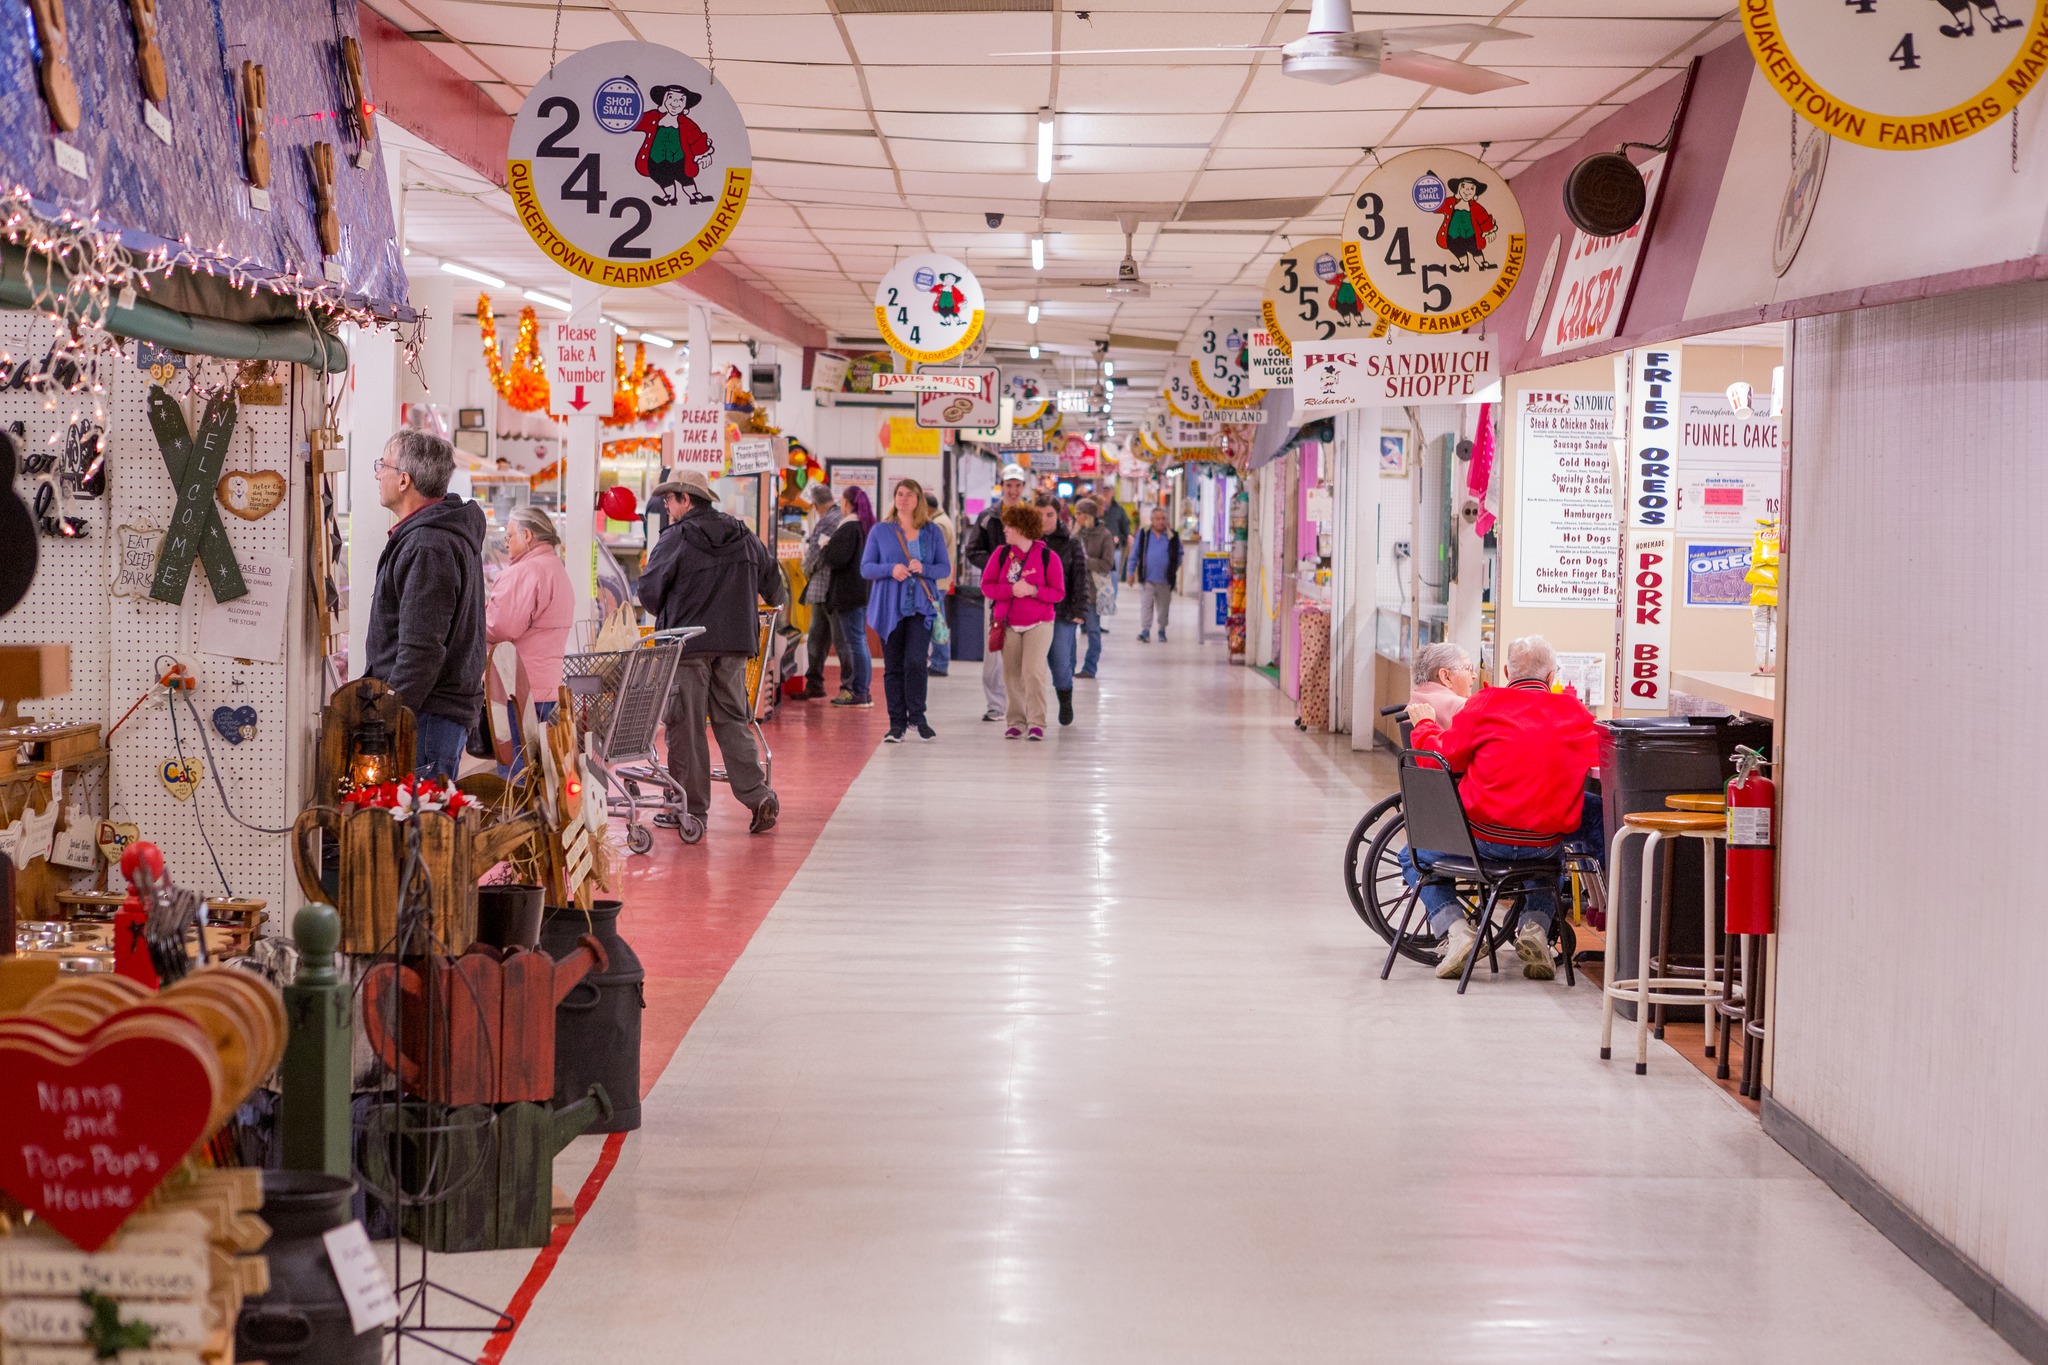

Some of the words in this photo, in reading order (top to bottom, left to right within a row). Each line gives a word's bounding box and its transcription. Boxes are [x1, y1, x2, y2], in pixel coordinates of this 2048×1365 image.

[1747, 0, 1866, 137] QUAKERTOWN
[1879, 97, 2001, 145] FARMERS
[2006, 3, 2048, 97] MARK
[605, 95, 633, 107] SHOP
[602, 105, 635, 116] SMALL
[1418, 192, 1440, 200] SMALL
[1419, 186, 1438, 194] SHOP
[511, 163, 594, 275] QUAKERTOWN
[602, 250, 694, 283] FARMERS
[697, 171, 745, 252] MARKET
[1344, 244, 1412, 326] QUAKERTOWN
[1419, 300, 1491, 331] FARMERS
[1492, 235, 1524, 299] MARKET
[558, 324, 597, 341] Please
[876, 307, 915, 357] QUAKERTOWN
[917, 348, 960, 360] FARMERS
[960, 311, 982, 350] MARKET
[1262, 302, 1292, 355] QUAKERTO
[558, 345, 586, 362] Take
[588, 346, 597, 362] A
[1264, 367, 1293, 375] LUGGA
[1303, 352, 1359, 372] BIG
[1366, 351, 1490, 377] SANDWICH
[558, 367, 606, 384] Number
[878, 374, 925, 389] DAVIS
[932, 375, 976, 391] MEATS
[1385, 373, 1475, 399] SHOPPE
[1642, 352, 1673, 430] FRIED
[1303, 396, 1356, 407] Richard's
[1525, 403, 1571, 414] Richard's
[1528, 393, 1569, 404] BIG
[1573, 395, 1614, 411] SANDWIC
[681, 409, 719, 424] PLEASE
[1202, 410, 1262, 422] CANDYLAND
[1690, 405, 1735, 418] Pennsylvan
[1530, 417, 1550, 429] Steak
[1551, 417, 1558, 429] &
[1560, 417, 1587, 430] Chicken
[1589, 418, 1609, 430] Steak
[683, 429, 709, 444] TAKE
[711, 429, 718, 444] A
[1011, 429, 1039, 438] LFORD
[1684, 422, 1738, 447] FUNNEL
[1743, 424, 1778, 449] CAKE
[1553, 439, 1582, 451] Sausage
[1584, 440, 1608, 450] Sandw
[677, 449, 723, 464] NUMBER
[735, 449, 770, 460] Thanksgiving
[736, 462, 754, 472] Order
[1559, 457, 1580, 467] Cold
[1584, 457, 1609, 471] Hoagi
[1551, 473, 1584, 486] Specialty
[1586, 474, 1610, 485] Sandwi
[1638, 447, 1670, 525] OREOS
[1559, 484, 1582, 496] Wraps
[1584, 485, 1591, 494] &
[1564, 508, 1612, 521] Hamburgers
[126, 534, 157, 549] EAT
[1563, 533, 1581, 543] Hot
[1586, 533, 1611, 545] Dogs
[1635, 539, 1665, 550] HOMEMADE
[124, 550, 155, 570] SLEEP
[1559, 555, 1581, 566] Corn
[1586, 555, 1608, 567] Dogs
[238, 564, 257, 573] EASE
[258, 566, 272, 575] NO
[1536, 568, 1568, 578] Chicken
[1572, 568, 1598, 581] Finger
[1601, 569, 1616, 579] Bas
[1537, 583, 1568, 594] Chicken
[1571, 585, 1600, 597] Nugget
[1603, 586, 1616, 595] Bas
[1635, 552, 1663, 625] PORK
[251, 599, 269, 608] CARTS
[227, 607, 254, 616] ALLOWED
[254, 609, 262, 617] IN
[239, 618, 258, 627] STORE
[1630, 643, 1660, 700] BBQ
[164, 761, 198, 784] Cats
[99, 823, 135, 850] Dogs
[36, 1079, 123, 1114] Nana
[63, 1109, 119, 1141] and
[20, 1143, 161, 1180] Pop-Pop's
[42, 1182, 134, 1212] House
